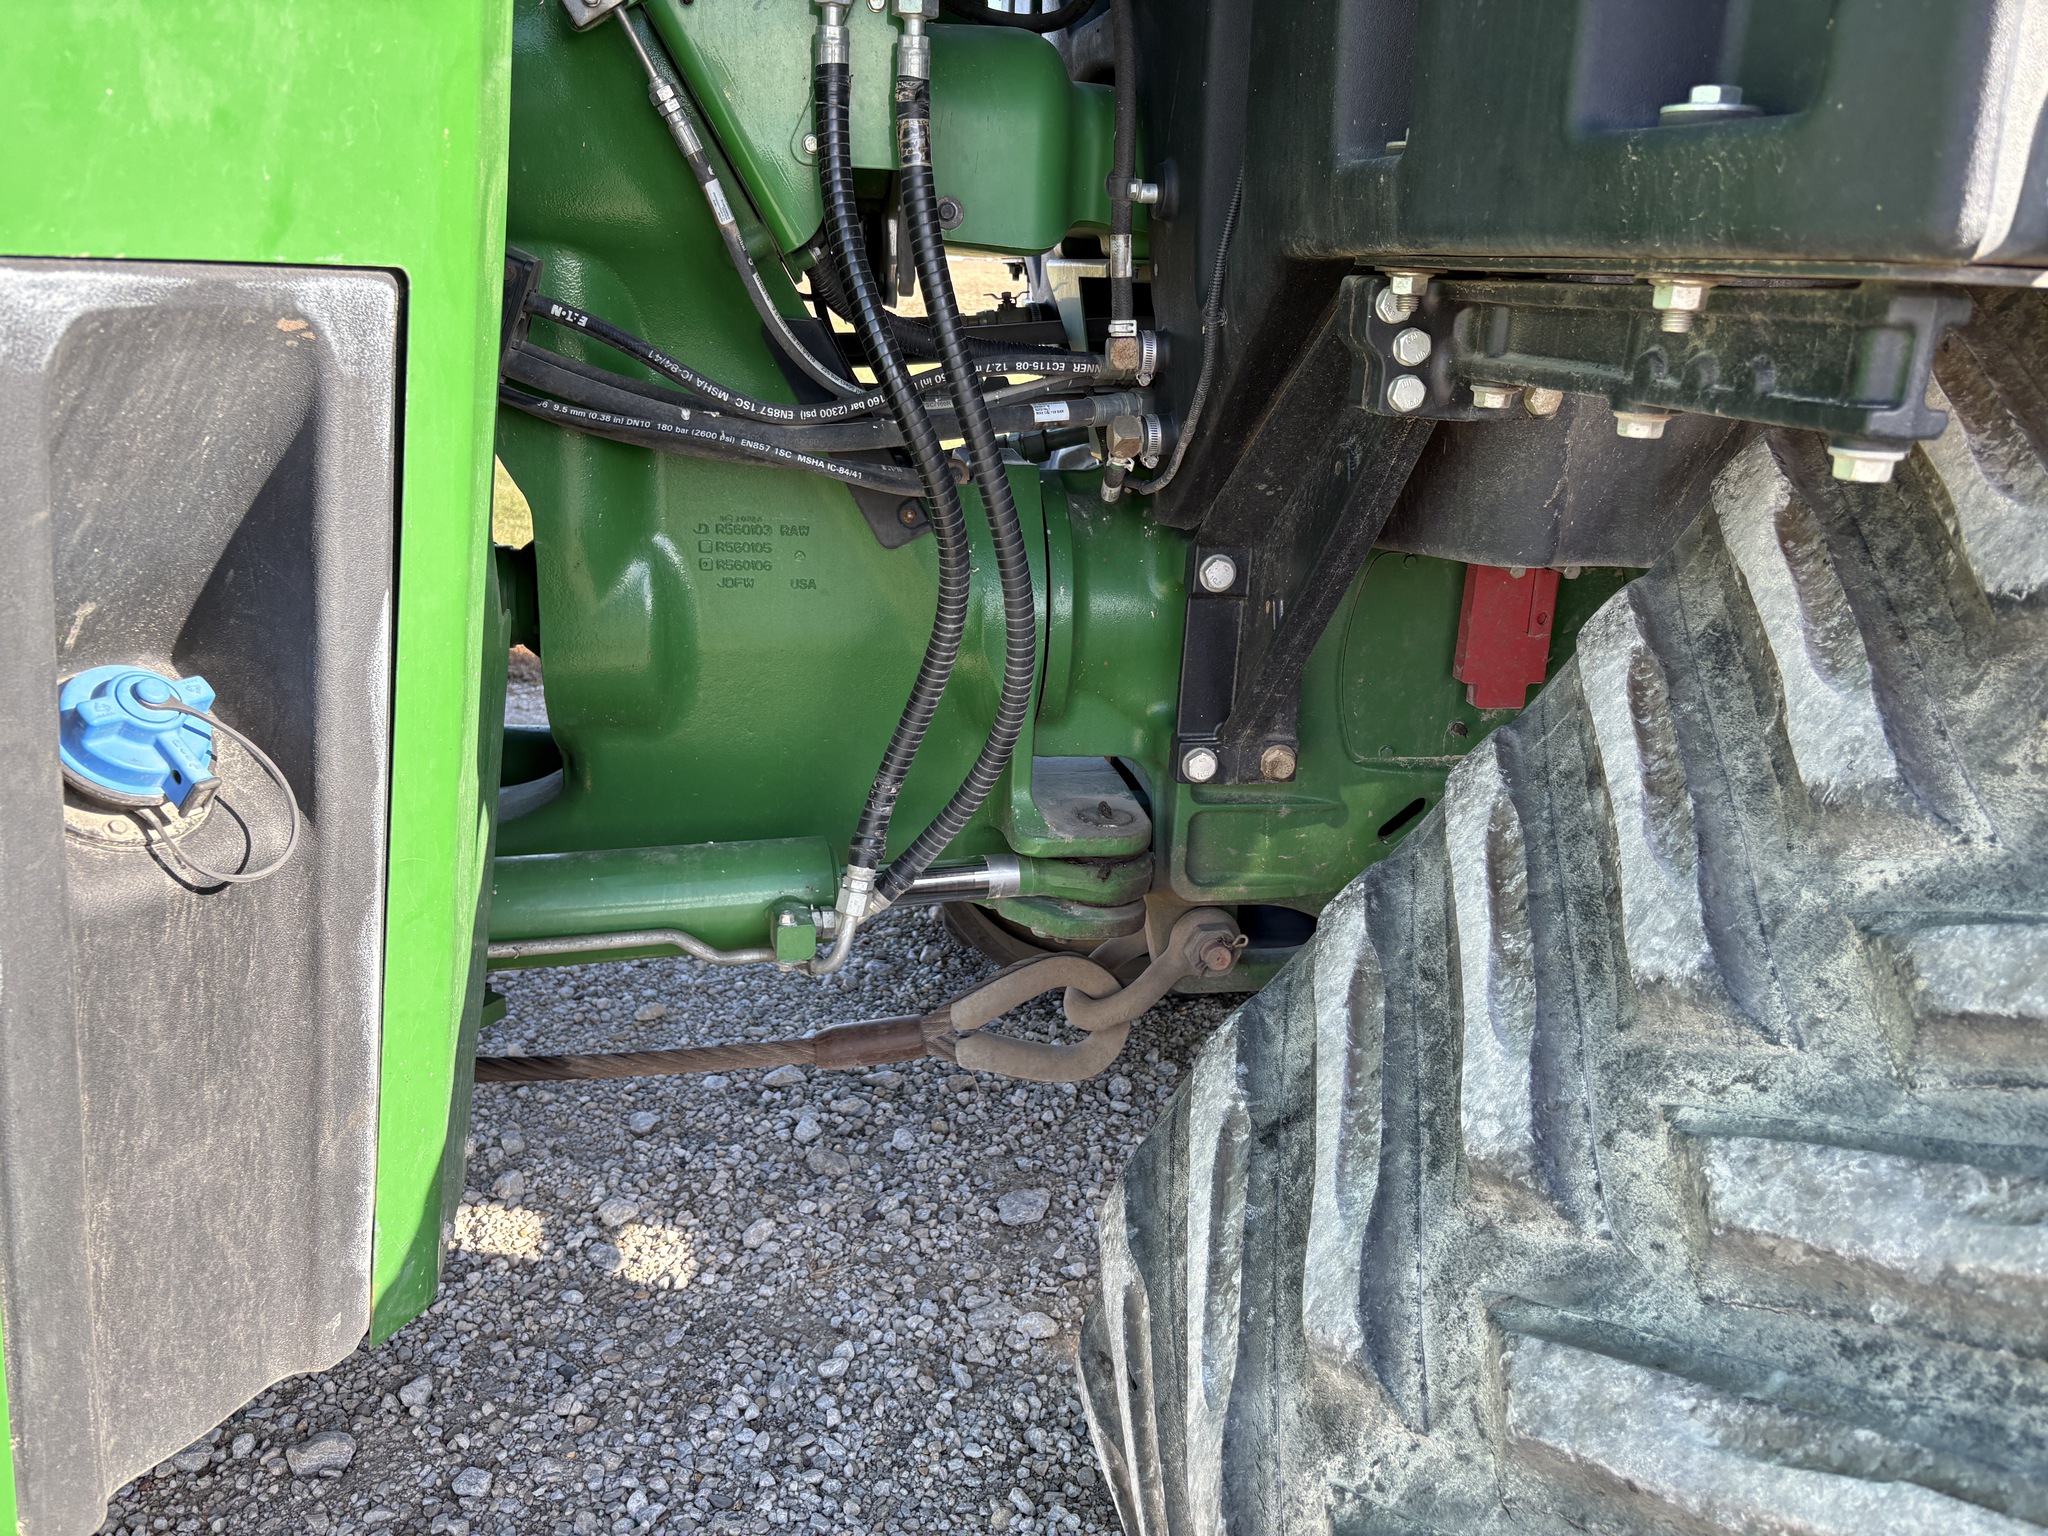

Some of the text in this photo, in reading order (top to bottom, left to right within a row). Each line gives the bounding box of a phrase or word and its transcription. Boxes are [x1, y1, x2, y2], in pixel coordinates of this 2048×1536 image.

[986, 362, 1008, 373] 12.7
[1015, 362, 1065, 372] EC115-08
[648, 350, 886, 420] 160 bar (2300 psi) EN857 1SC MSHA IC-84/41
[553, 403, 569, 414] 9.5
[570, 409, 586, 418] mm
[588, 411, 611, 423] (0.38
[612, 416, 624, 426] in)
[626, 418, 651, 429] DN10
[657, 423, 673, 432] 180
[675, 425, 689, 435] bar
[691, 428, 718, 440] (2600
[740, 438, 771, 453] EN857
[774, 447, 793, 459] 1SC
[797, 453, 826, 469] MSHA
[827, 460, 863, 480] IC-84/41
[780, 524, 810, 537] RAW
[715, 541, 773, 554] R560105
[716, 559, 773, 572] R560106
[790, 578, 817, 590] USA
